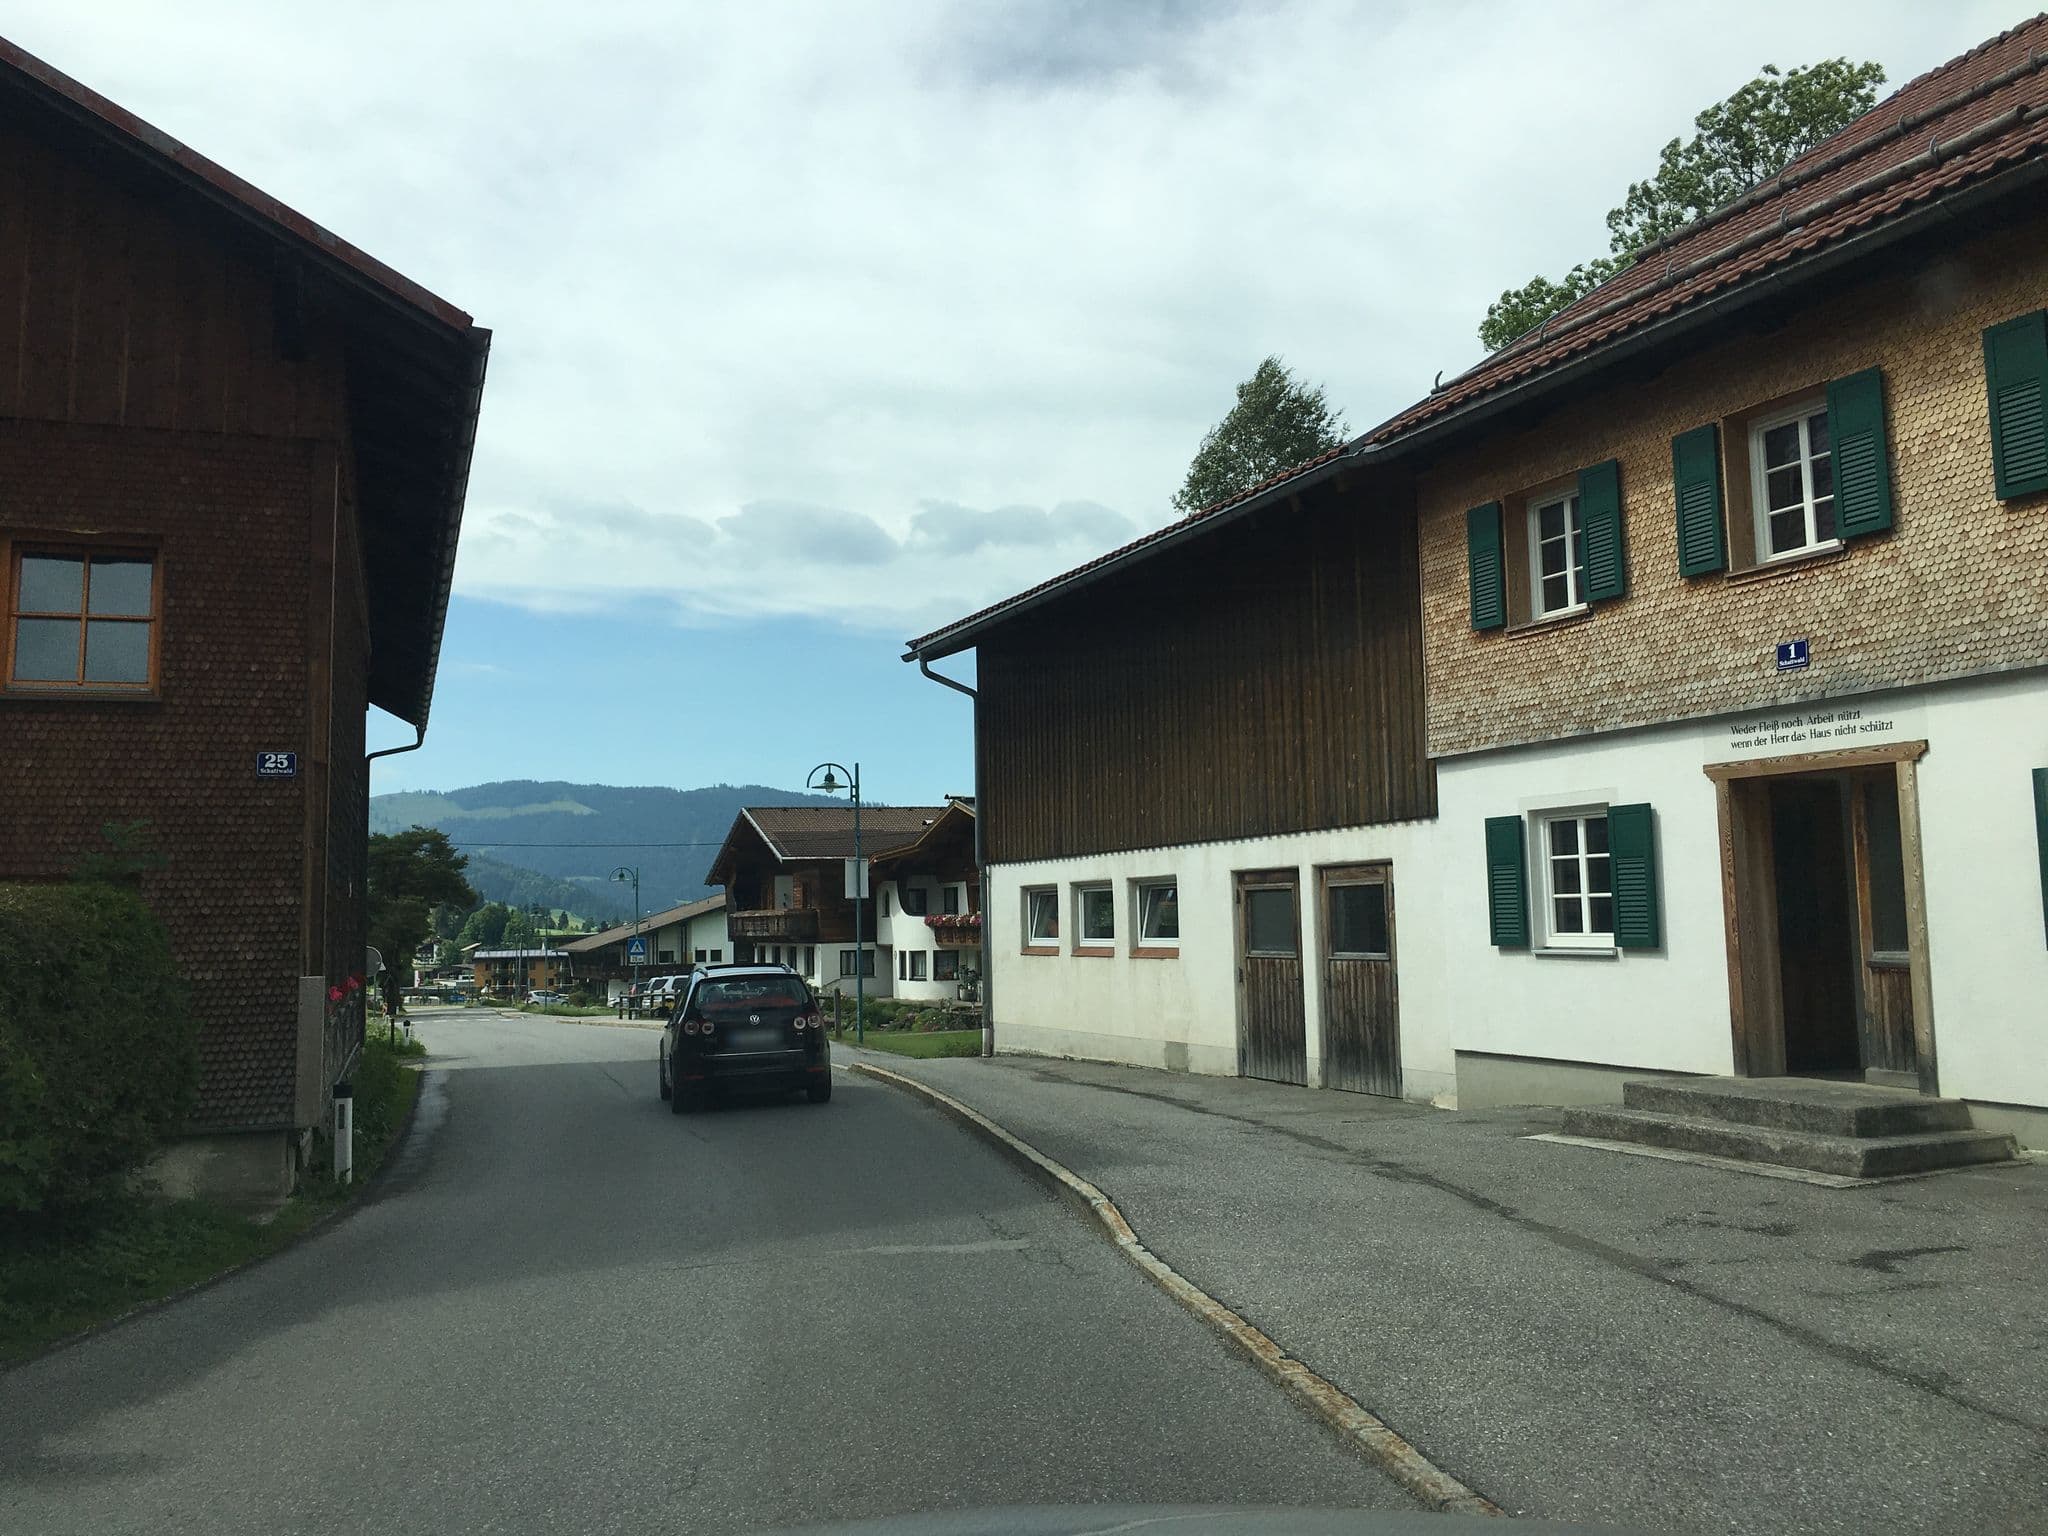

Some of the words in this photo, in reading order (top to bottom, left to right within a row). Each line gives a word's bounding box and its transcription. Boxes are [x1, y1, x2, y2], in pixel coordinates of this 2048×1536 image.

[1788, 643, 1796, 658] 1
[1731, 724, 1757, 735] Weder
[1759, 720, 1779, 733] Fleiß
[1781, 716, 1803, 729] noch
[1806, 712, 1834, 726] Arbeit
[1731, 740, 1752, 749] wenn
[1754, 736, 1767, 746] der
[1771, 733, 1789, 744] Herr
[1791, 731, 1806, 742] das
[1810, 728, 1832, 739] Haus
[1834, 724, 1857, 736] nicht
[1860, 720, 1894, 733] schützt
[264, 753, 289, 768] 25
